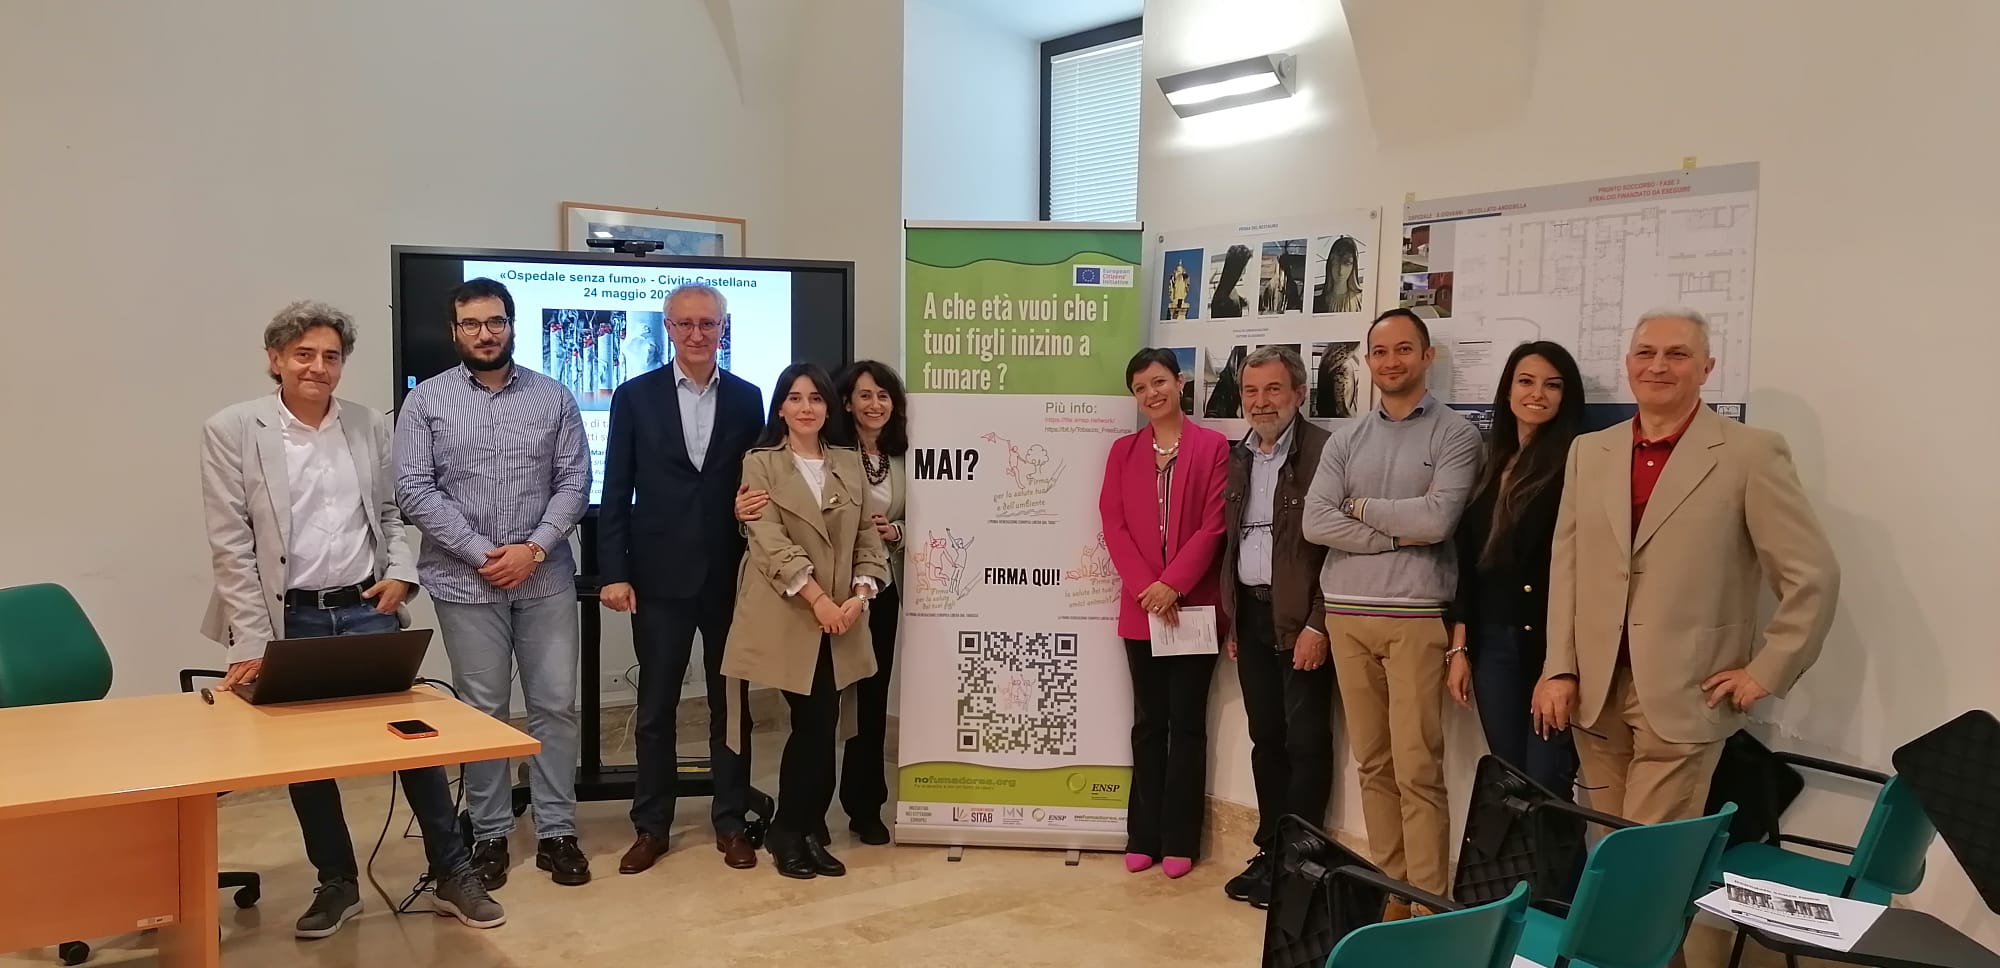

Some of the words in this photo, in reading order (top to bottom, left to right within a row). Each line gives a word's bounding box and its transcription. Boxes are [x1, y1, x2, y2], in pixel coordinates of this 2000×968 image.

[569, 273, 605, 283] senza
[658, 274, 692, 286] Civita
[696, 276, 757, 288] Castellana
[583, 287, 598, 298] 24
[601, 288, 646, 301] maggio
[924, 291, 937, 320] A
[943, 294, 976, 320] che
[981, 293, 1012, 321] età
[1018, 293, 1057, 321] vuoi
[1063, 294, 1097, 322] che
[1102, 294, 1108, 322] i
[923, 327, 961, 355] tuoi
[966, 327, 1005, 361] figli
[1011, 328, 1073, 356] inizino
[1079, 335, 1090, 356] a
[922, 362, 991, 391] fumare
[997, 362, 1008, 391] ?
[1045, 402, 1065, 414] Più
[1070, 402, 1097, 414] info:
[914, 448, 979, 481] MAI?
[984, 567, 1028, 586] FIRMA
[1032, 568, 1061, 587] QUI!
[1091, 783, 1120, 792] ENSP
[971, 812, 993, 823] SITAB
